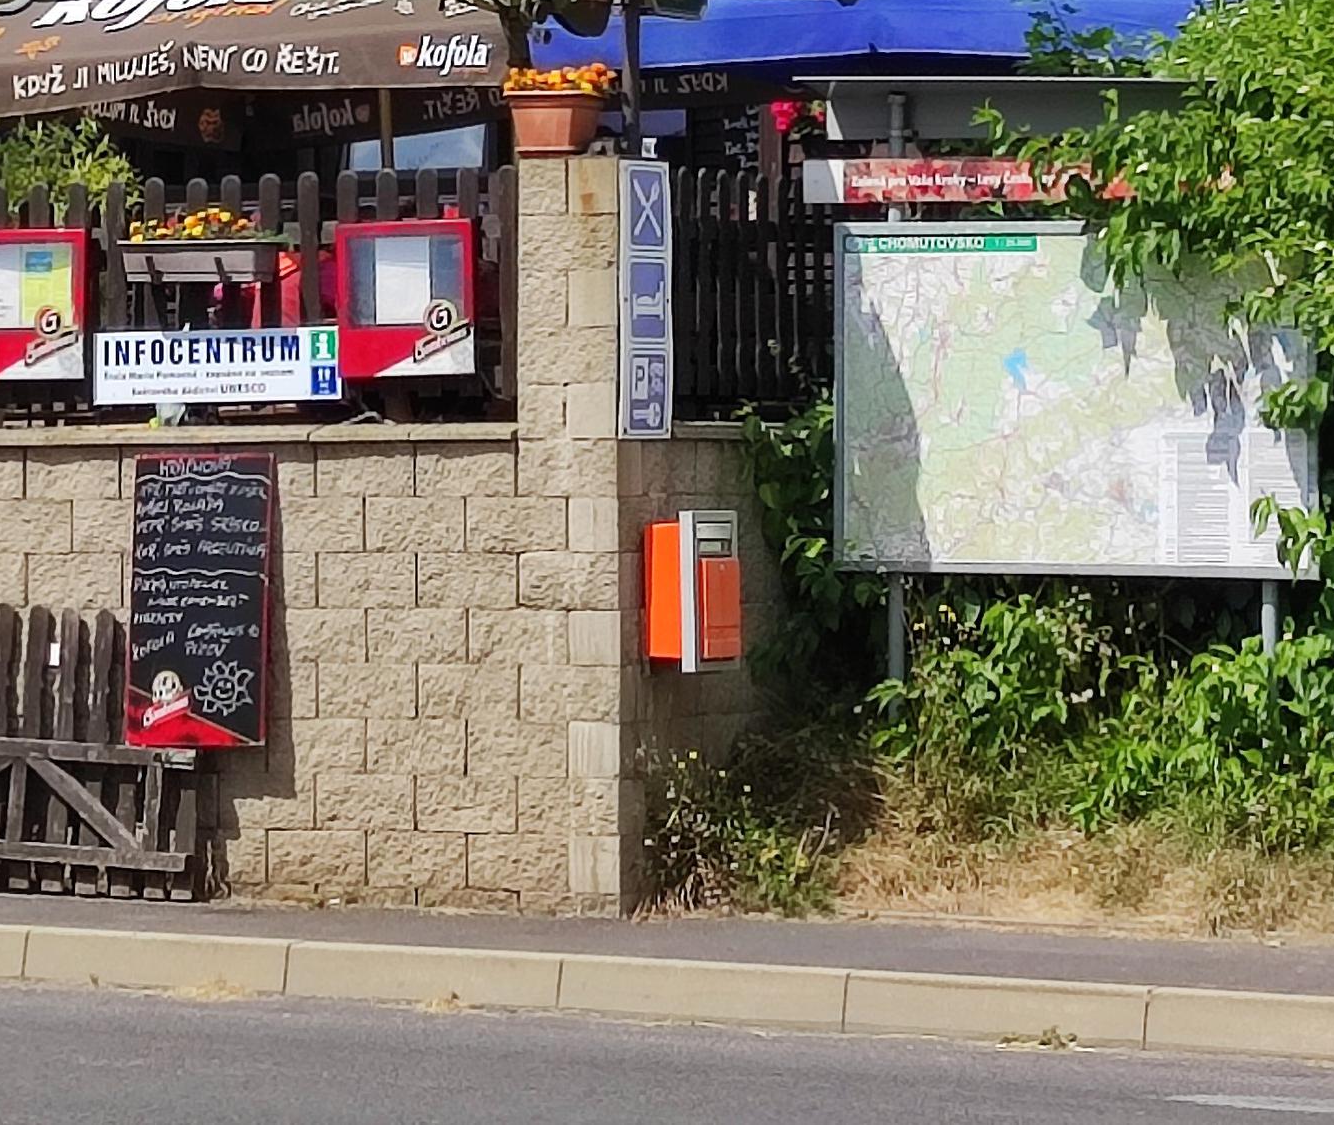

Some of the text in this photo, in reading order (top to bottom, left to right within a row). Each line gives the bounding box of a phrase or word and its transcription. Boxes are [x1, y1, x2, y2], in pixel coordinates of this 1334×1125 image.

[12, 40, 340, 100] KDYŽ JI MILUJEŠ, NENÍ CO ŘEŠIT.
[417, 34, 490, 77] kofola
[878, 236, 985, 250] CHOMUTOVSKO
[103, 334, 300, 367] INFOCENTRUM
